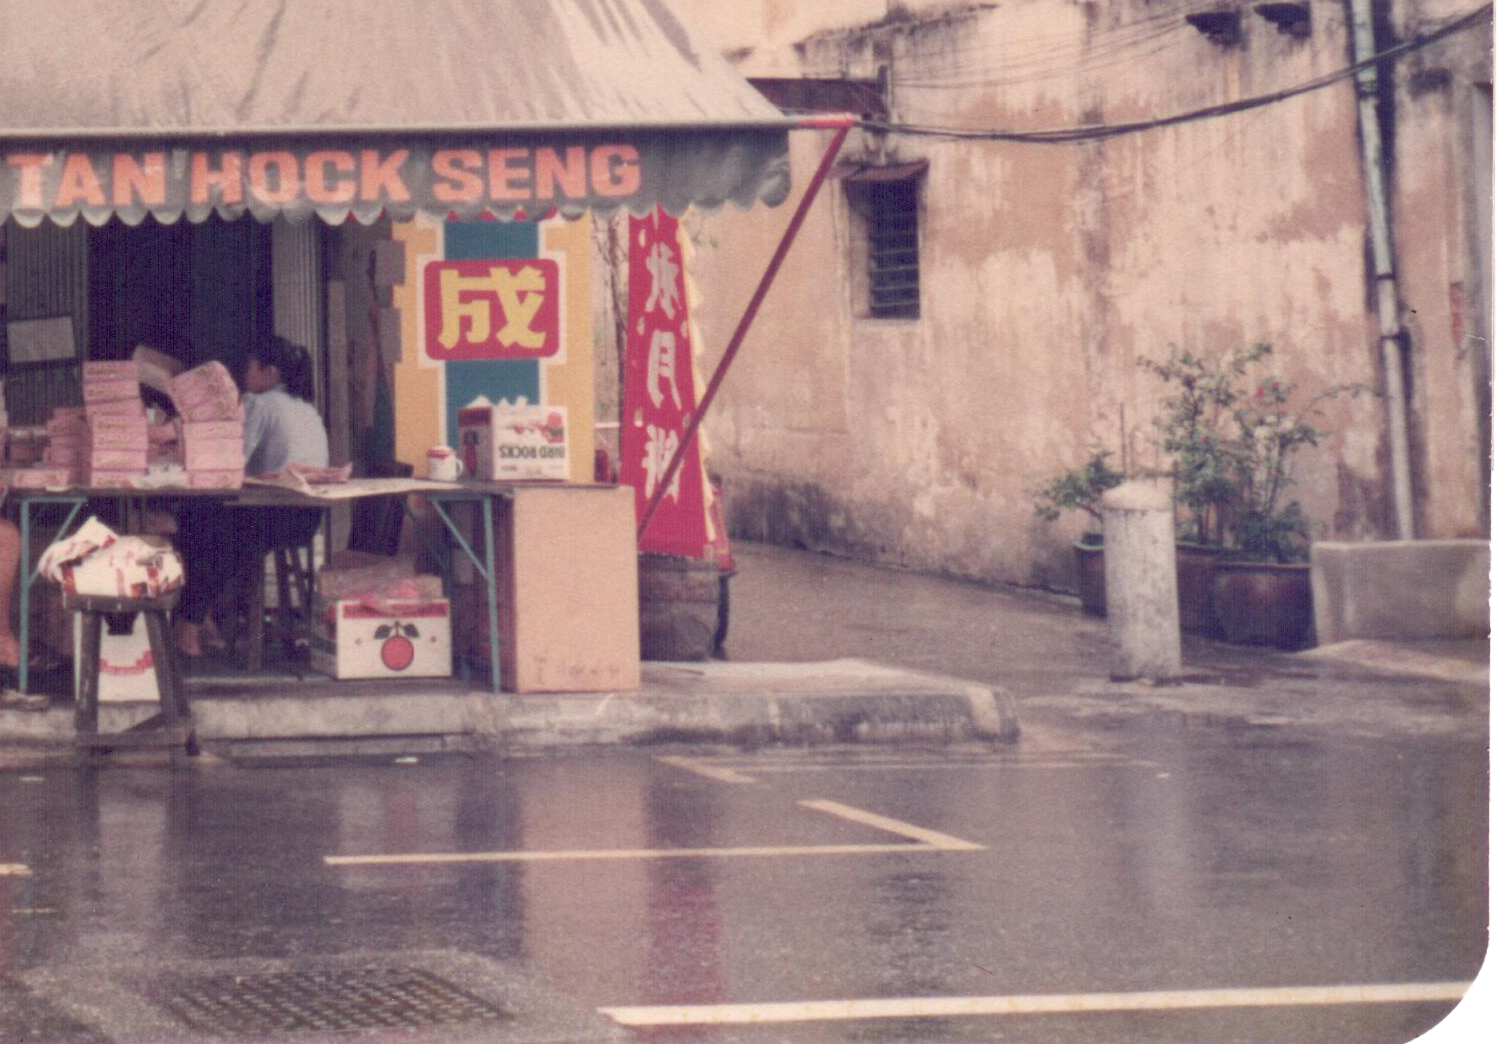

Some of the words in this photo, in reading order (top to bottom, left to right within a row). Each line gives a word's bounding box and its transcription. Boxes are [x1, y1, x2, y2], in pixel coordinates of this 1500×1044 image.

[8, 152, 166, 207] TAN
[190, 149, 411, 205] HOCK
[431, 144, 641, 203] SENG
[437, 264, 547, 350] 成
